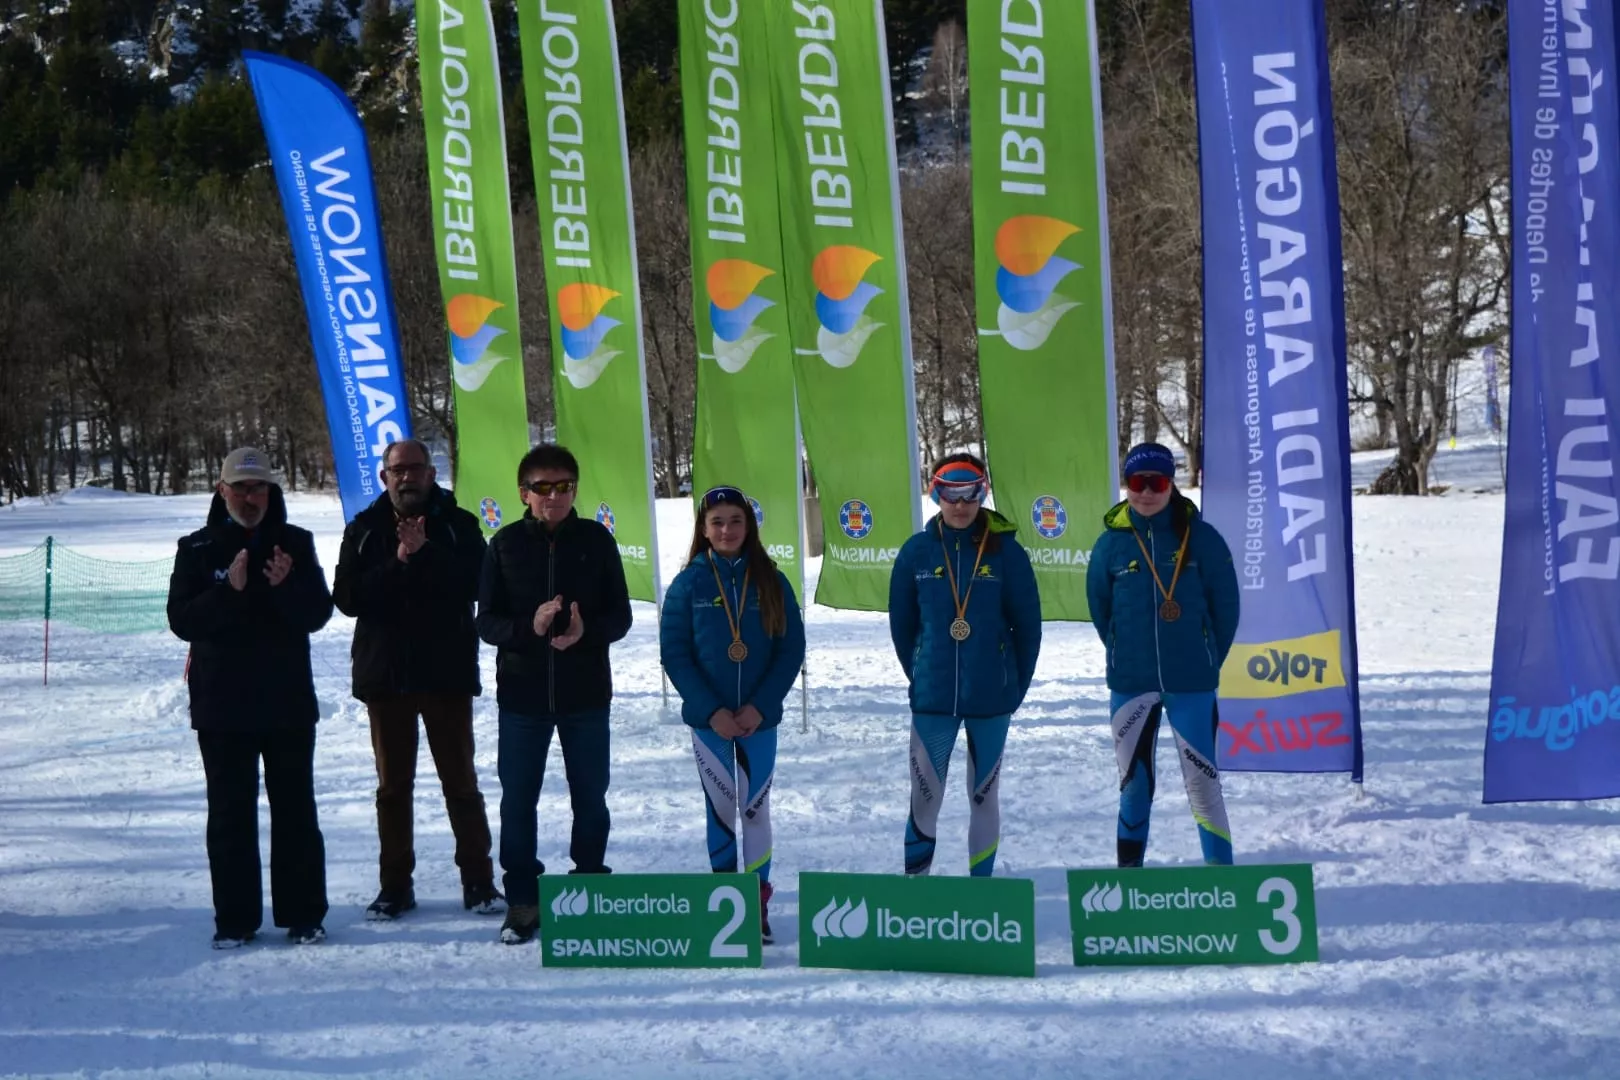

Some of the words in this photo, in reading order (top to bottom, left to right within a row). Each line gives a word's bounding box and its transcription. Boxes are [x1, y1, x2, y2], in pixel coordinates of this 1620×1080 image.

[593, 893, 690, 915] Iberdrola
[1128, 886, 1237, 910] Iberdrola
[707, 885, 749, 958] 2
[876, 907, 1022, 943] Iberdrola
[1256, 876, 1302, 955] 3
[551, 938, 691, 957] SPAINSNOW
[1083, 933, 1238, 956] SPAINSNOW
